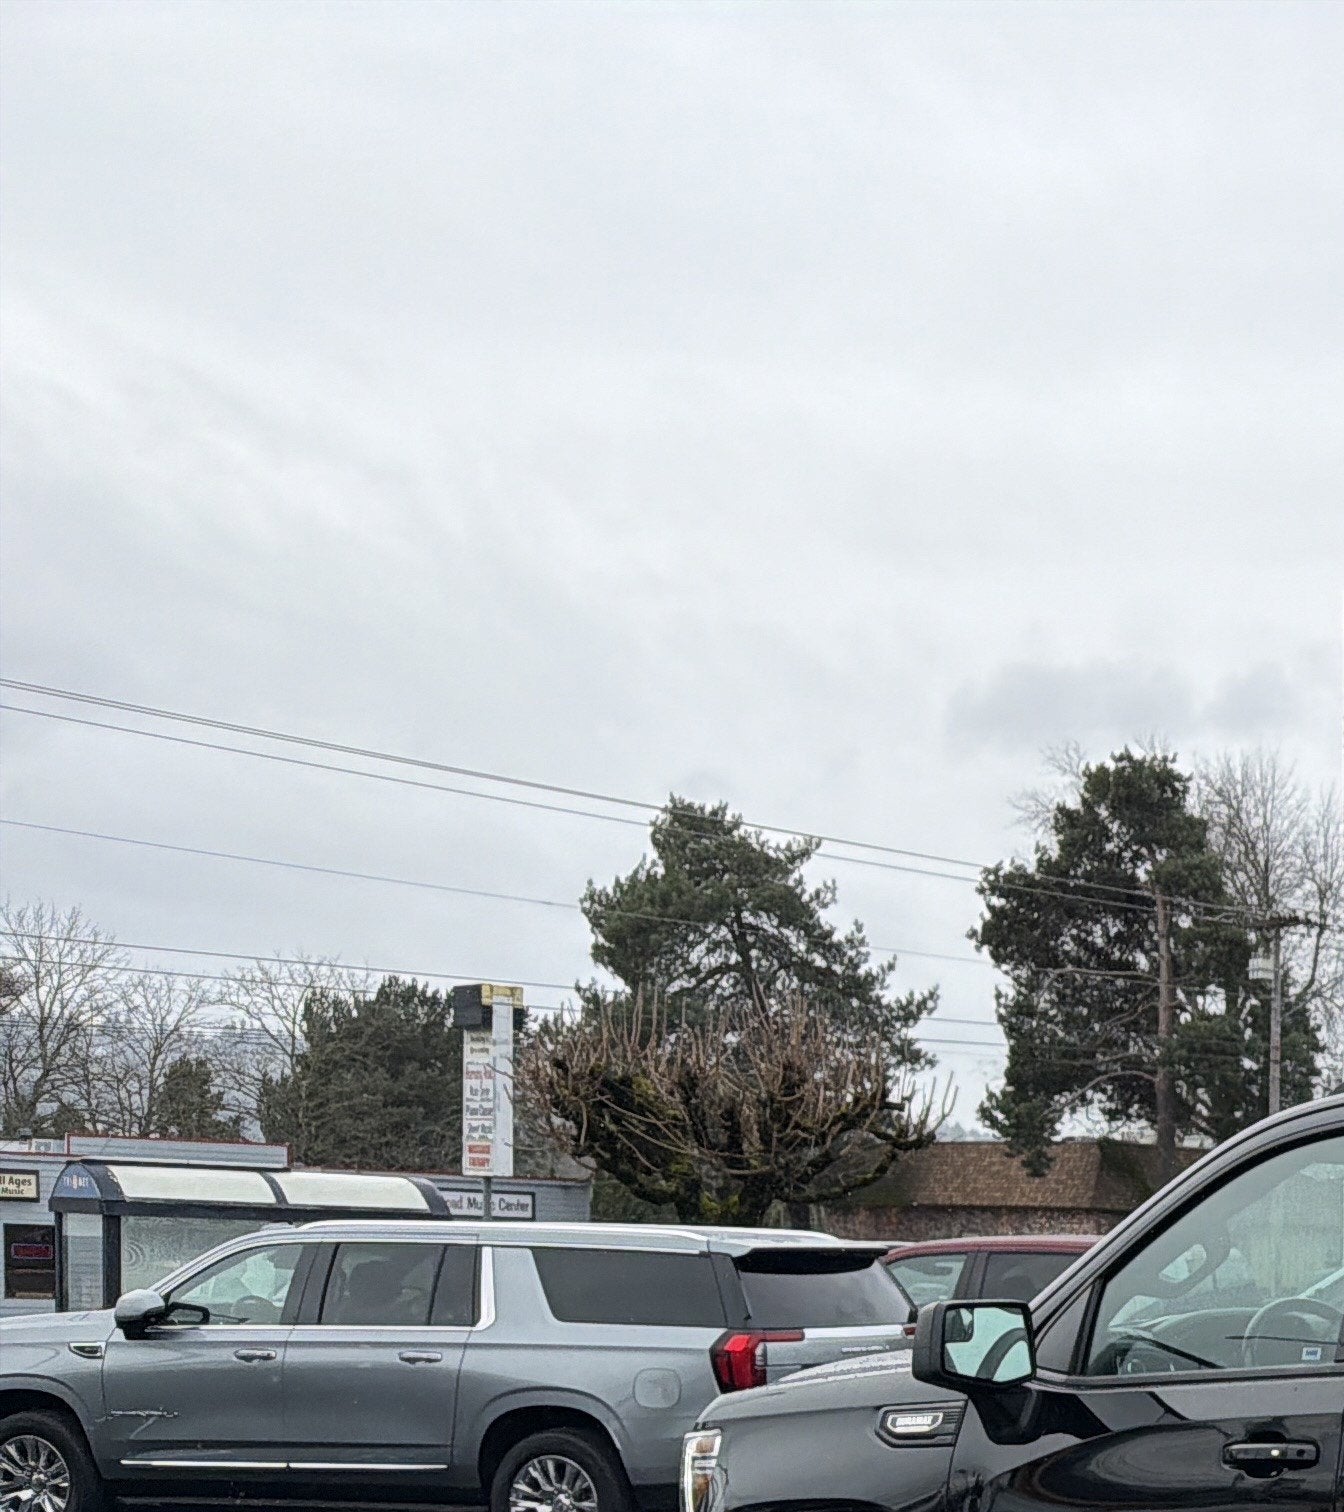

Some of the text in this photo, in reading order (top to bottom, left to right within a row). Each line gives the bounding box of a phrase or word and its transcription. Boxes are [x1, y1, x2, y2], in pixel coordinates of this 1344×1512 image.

[8, 1176, 32, 1187] Ages
[466, 1196, 496, 1211] Muc
[498, 1197, 530, 1212] Center
